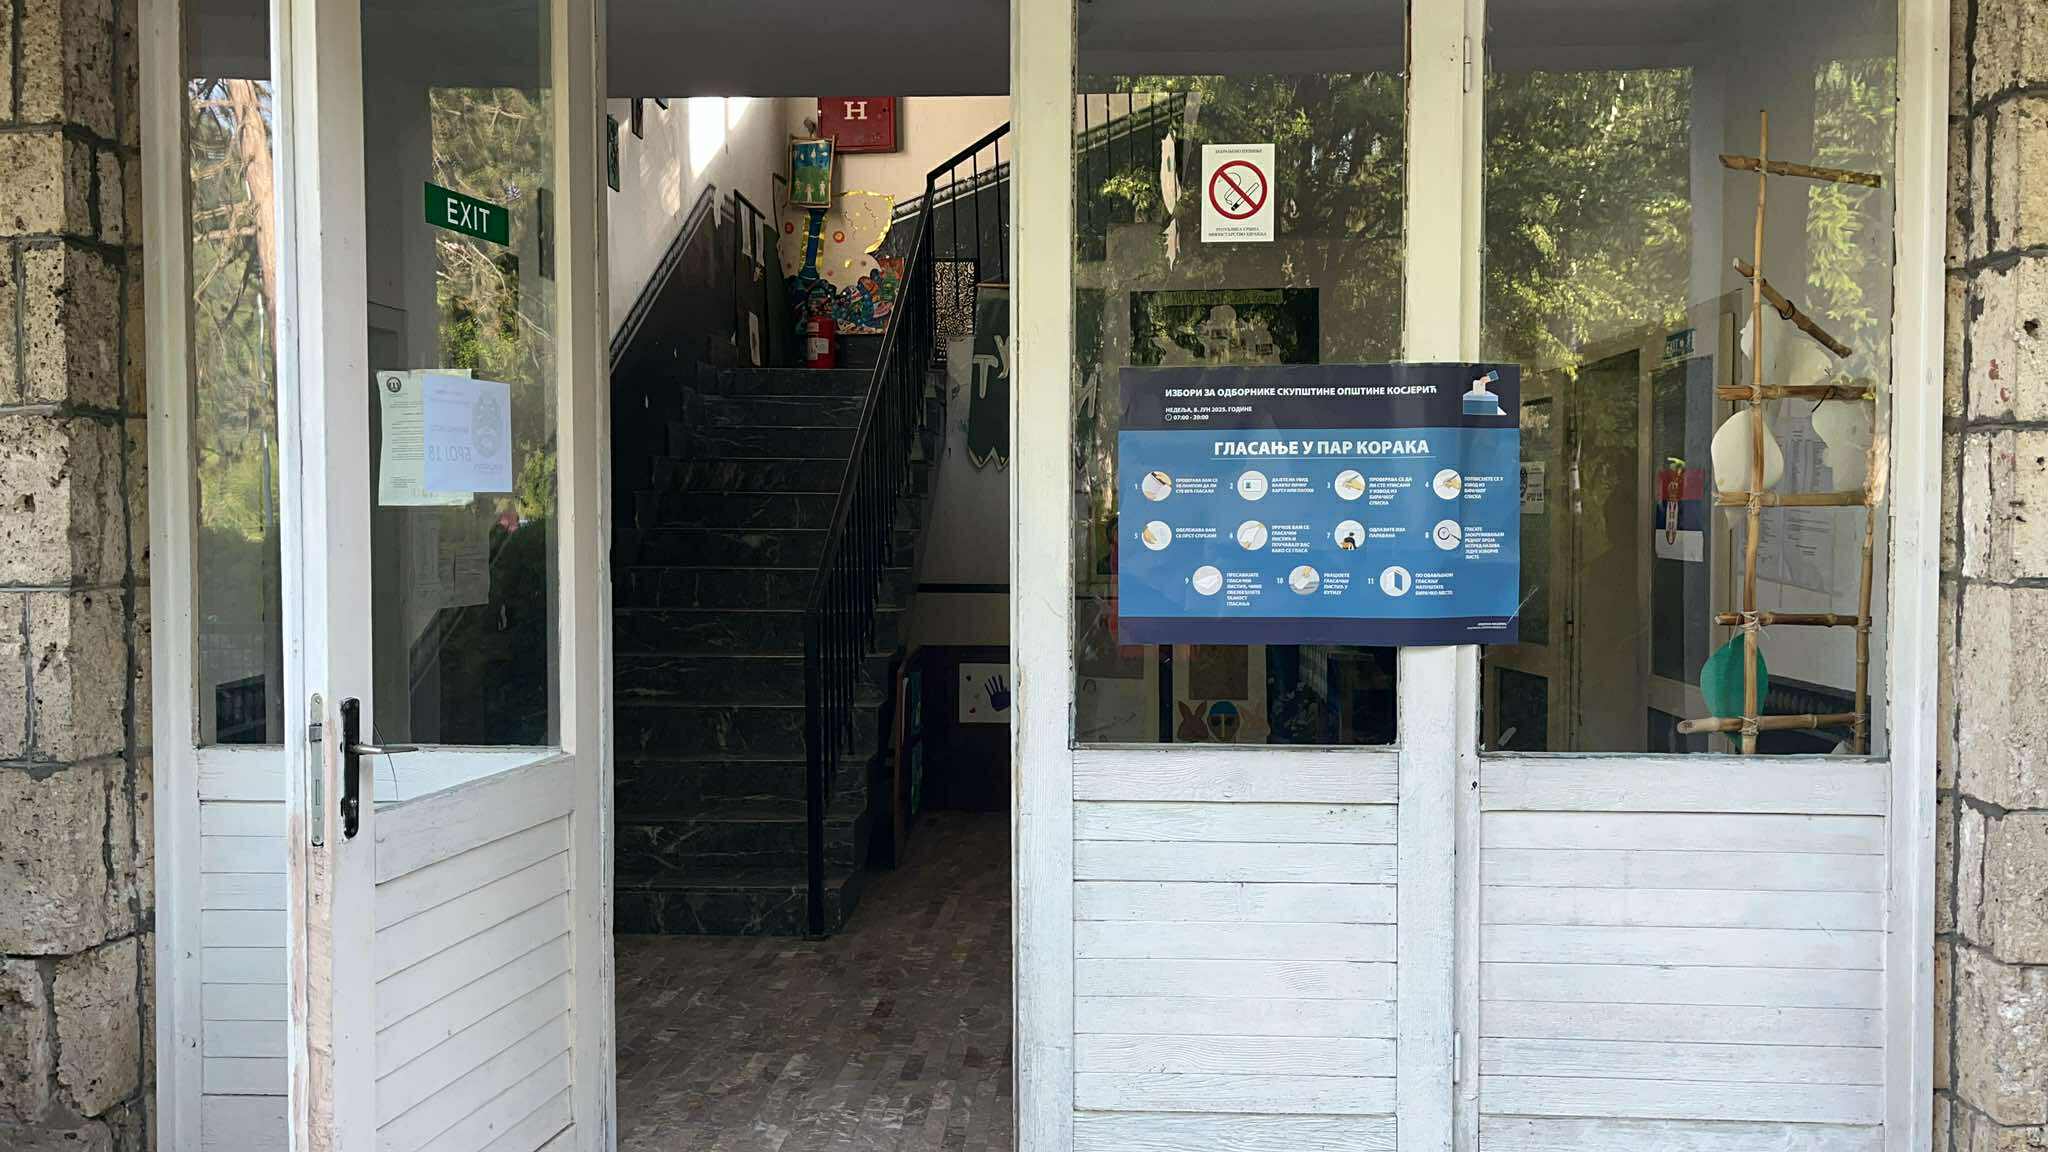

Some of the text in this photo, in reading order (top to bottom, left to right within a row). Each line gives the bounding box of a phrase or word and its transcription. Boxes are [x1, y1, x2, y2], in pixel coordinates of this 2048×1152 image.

[844, 101, 867, 120] H
[447, 197, 490, 233] EXIT
[1165, 385, 1437, 398] ИЗБОРИ ЗА ОДБОРНИКЕ СКУПШТИНЕ ОПШТИНЕ КОСЈЕРИЋ
[1214, 440, 1430, 455] ГЛАСАЊЕ У ПАР КОРАКА
